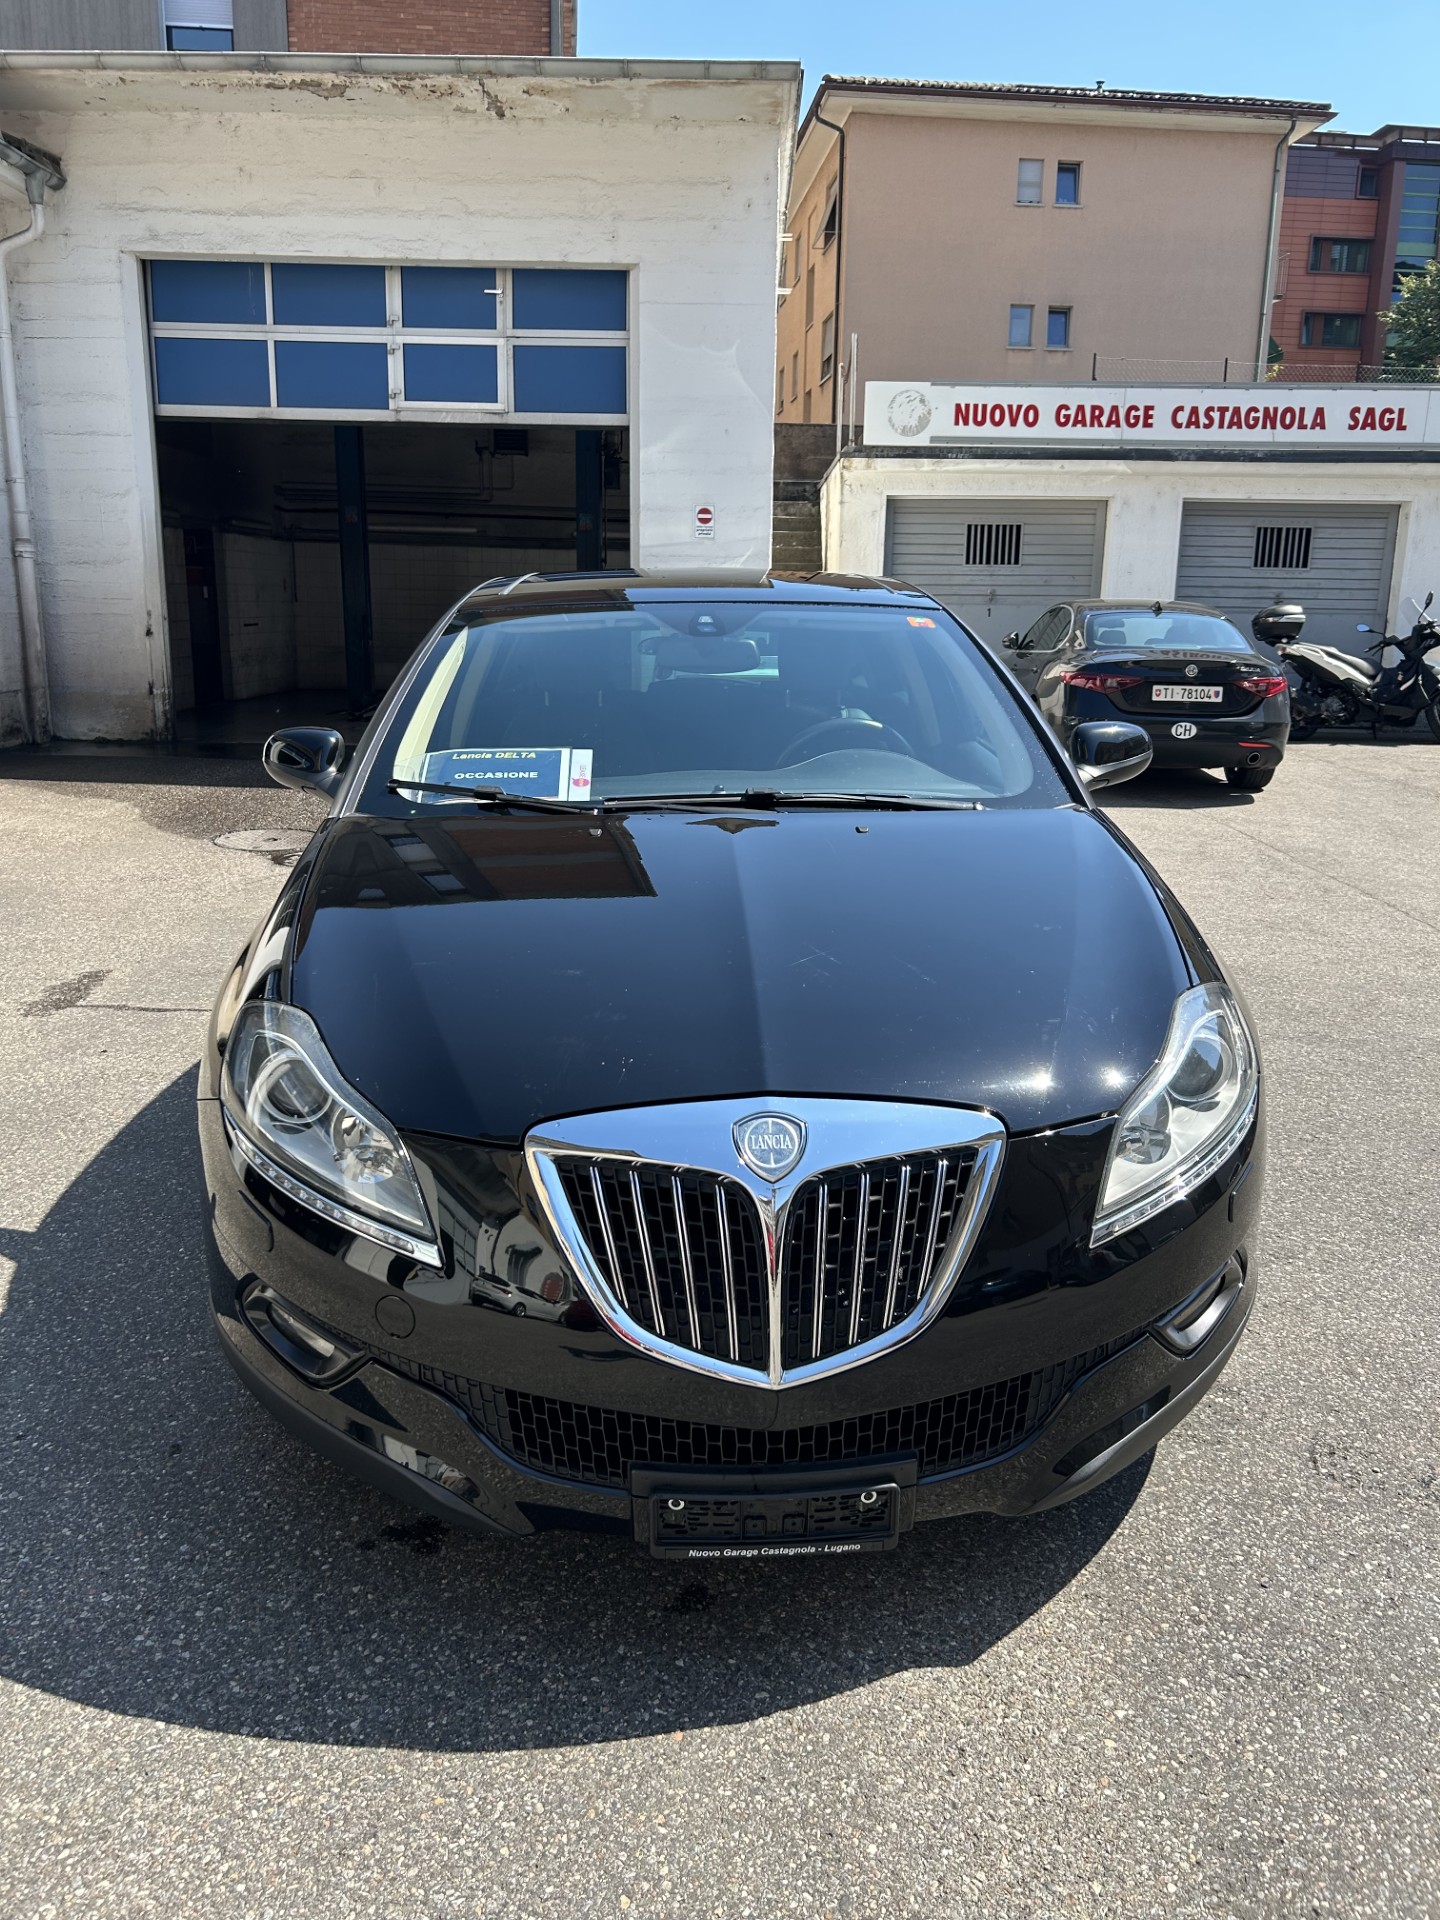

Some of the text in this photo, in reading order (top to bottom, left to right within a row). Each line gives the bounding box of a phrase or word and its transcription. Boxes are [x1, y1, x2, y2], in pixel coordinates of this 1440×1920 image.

[953, 403, 1408, 432] NUOVO GARAGE CASTAGNOLA SAGL
[1174, 724, 1192, 737] CH
[452, 752, 492, 760] Lancia
[750, 1134, 793, 1150] LANCIA
[688, 1549, 721, 1557] Nuovo
[723, 1548, 758, 1558] Garage
[761, 1545, 816, 1556] Castagnola
[824, 1543, 861, 1554] Lugano
